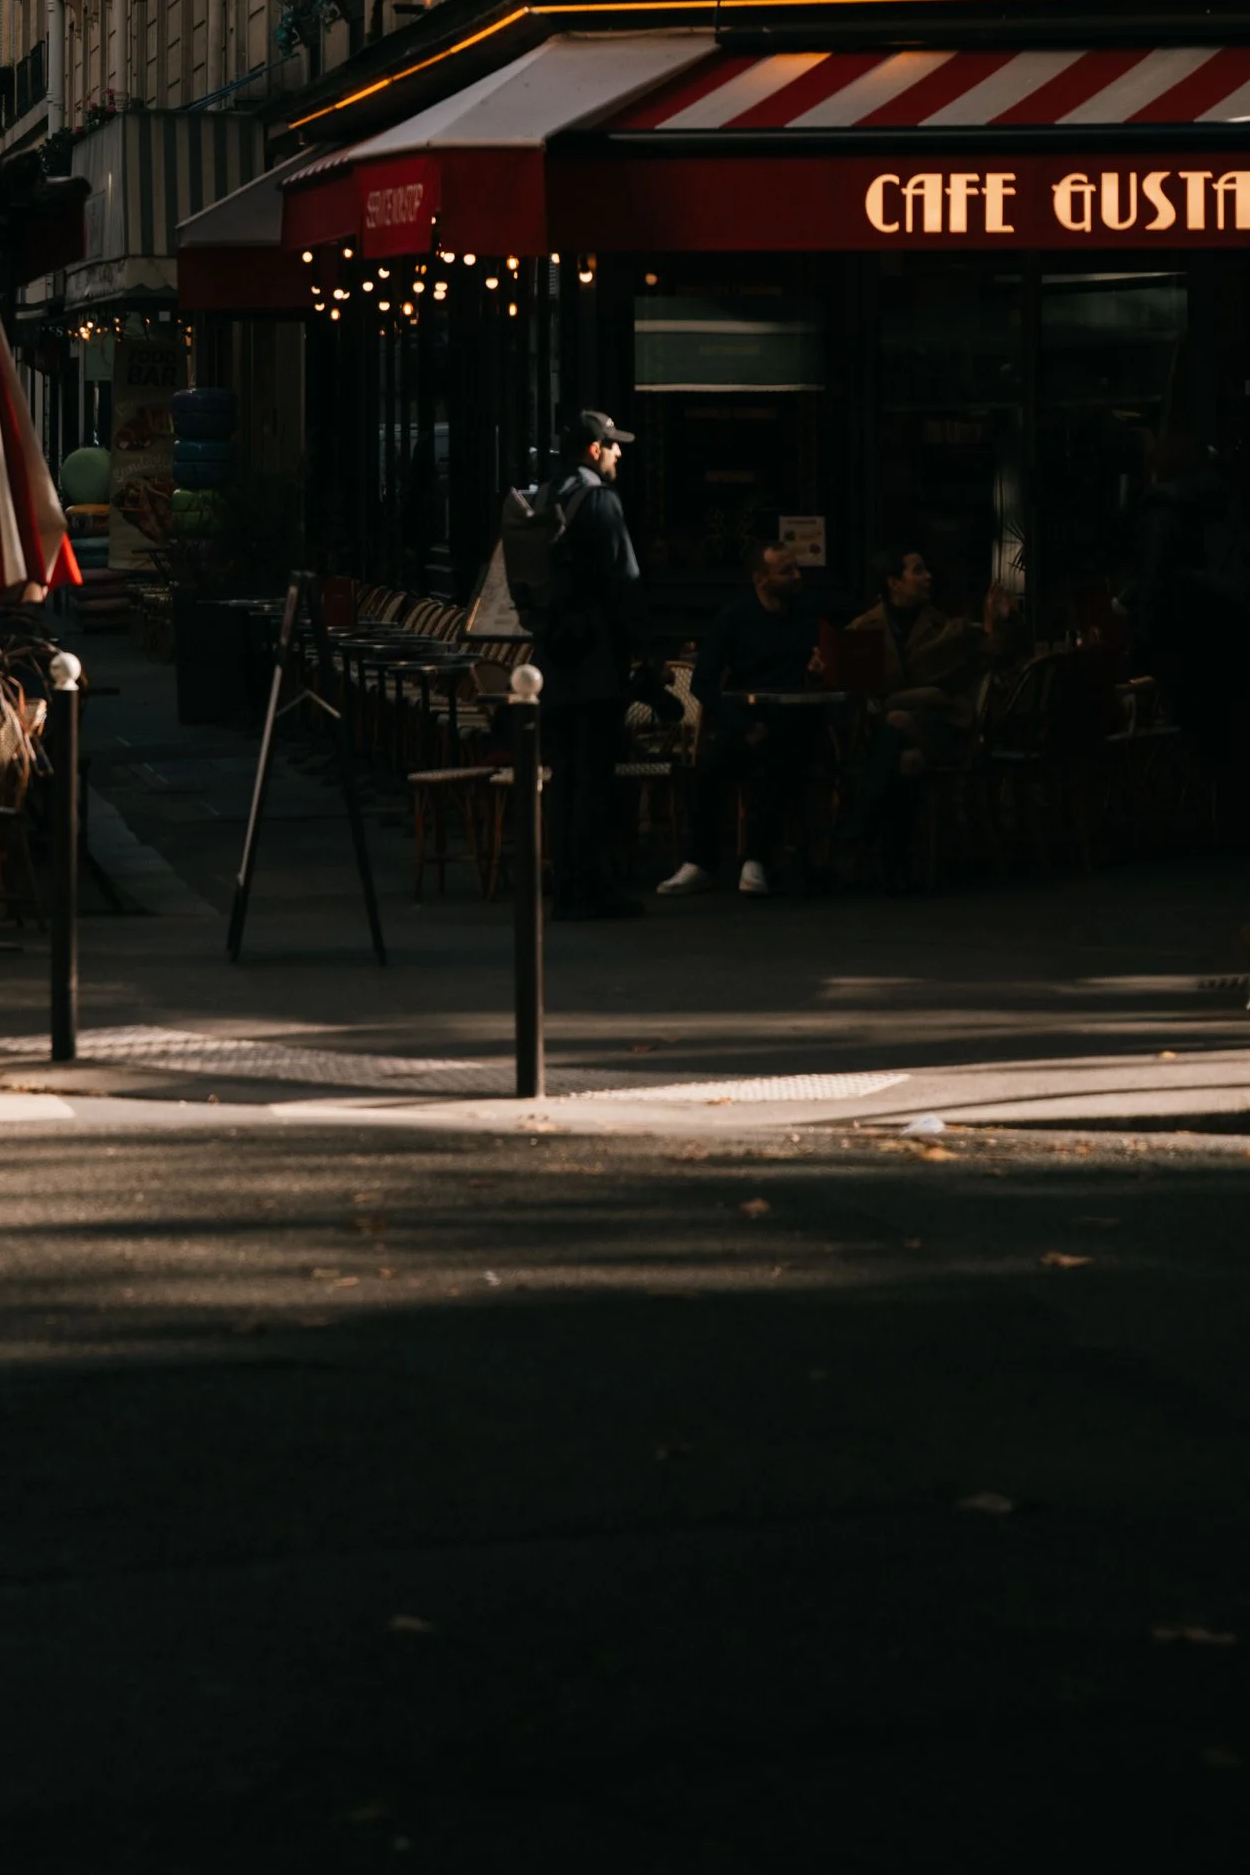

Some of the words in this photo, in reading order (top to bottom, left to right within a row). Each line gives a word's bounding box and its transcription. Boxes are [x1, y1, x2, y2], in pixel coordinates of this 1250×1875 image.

[864, 172, 1016, 234] CAFE
[1051, 170, 1250, 233] GUSTA
[129, 348, 177, 366] FOOD
[126, 364, 177, 387] BAR
